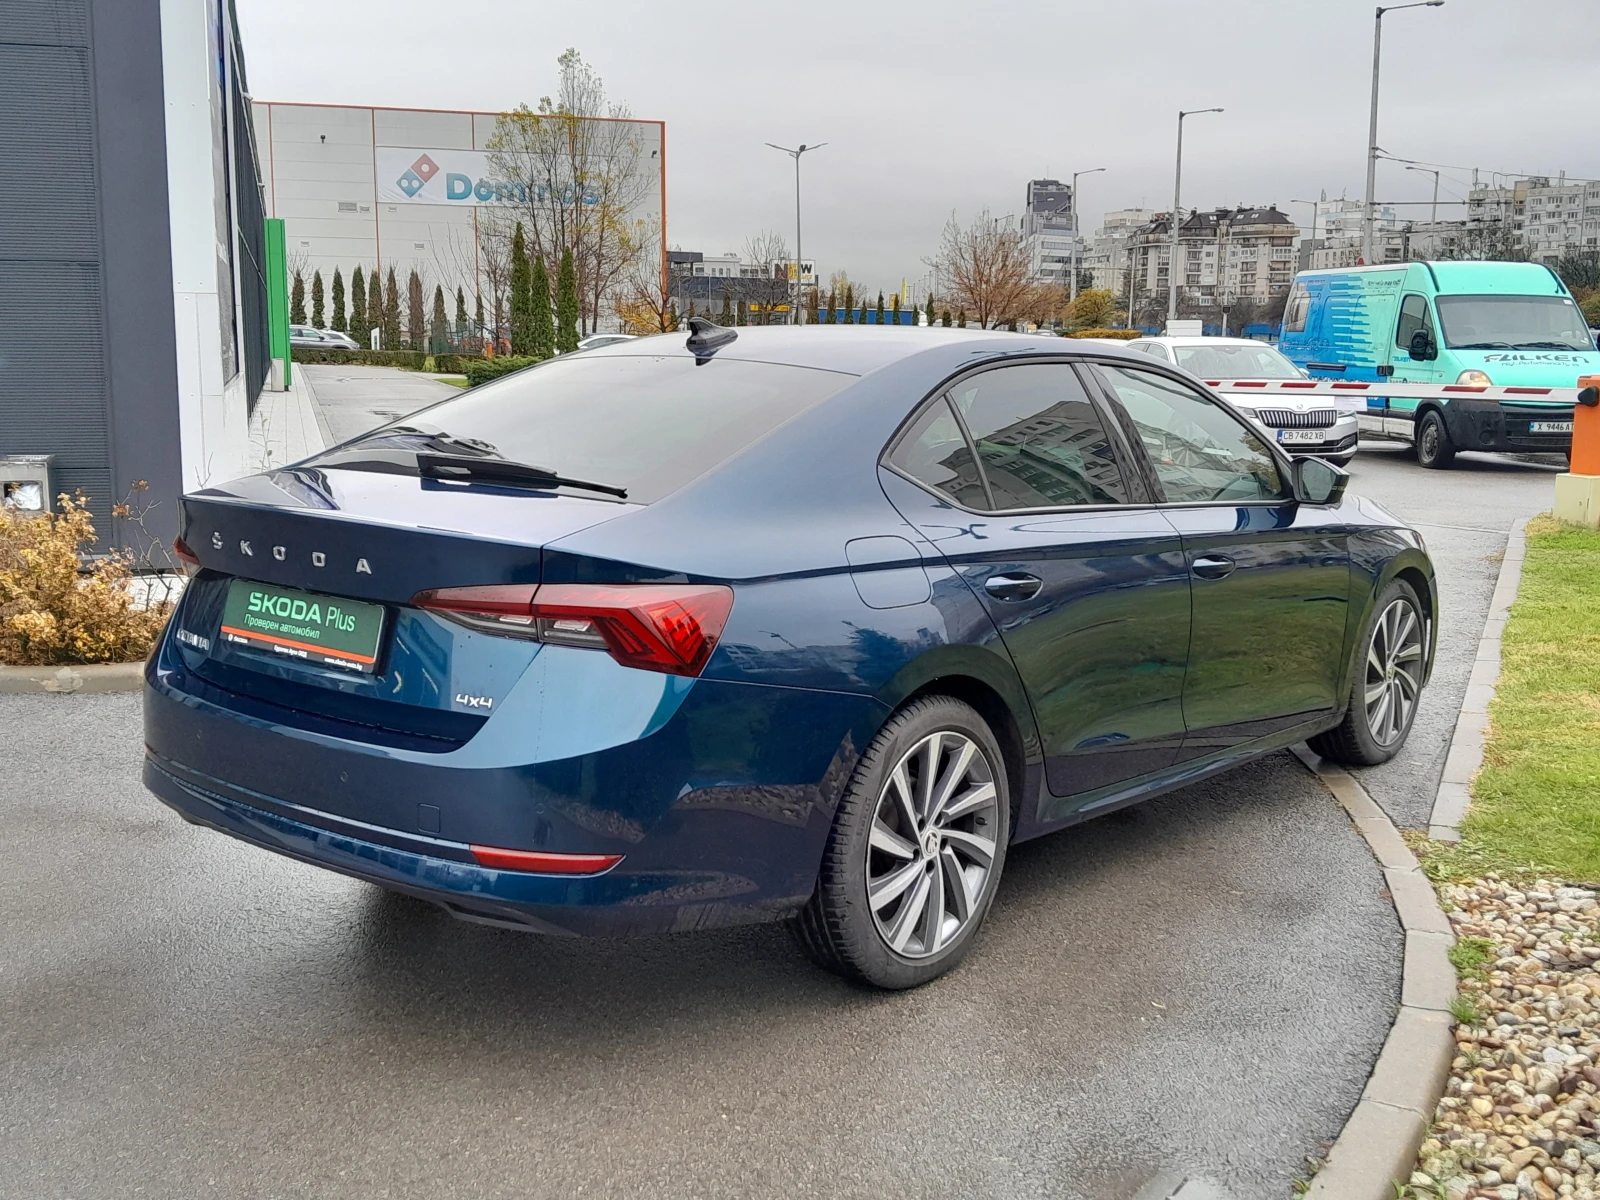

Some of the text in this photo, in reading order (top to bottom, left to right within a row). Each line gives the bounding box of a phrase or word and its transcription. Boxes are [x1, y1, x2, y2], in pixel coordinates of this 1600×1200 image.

[1283, 431, 1294, 440] CB
[1295, 431, 1313, 440] 7482
[244, 613, 320, 639] Проверен автомобил
[325, 606, 356, 632] Plus
[455, 693, 492, 709] 4x4
